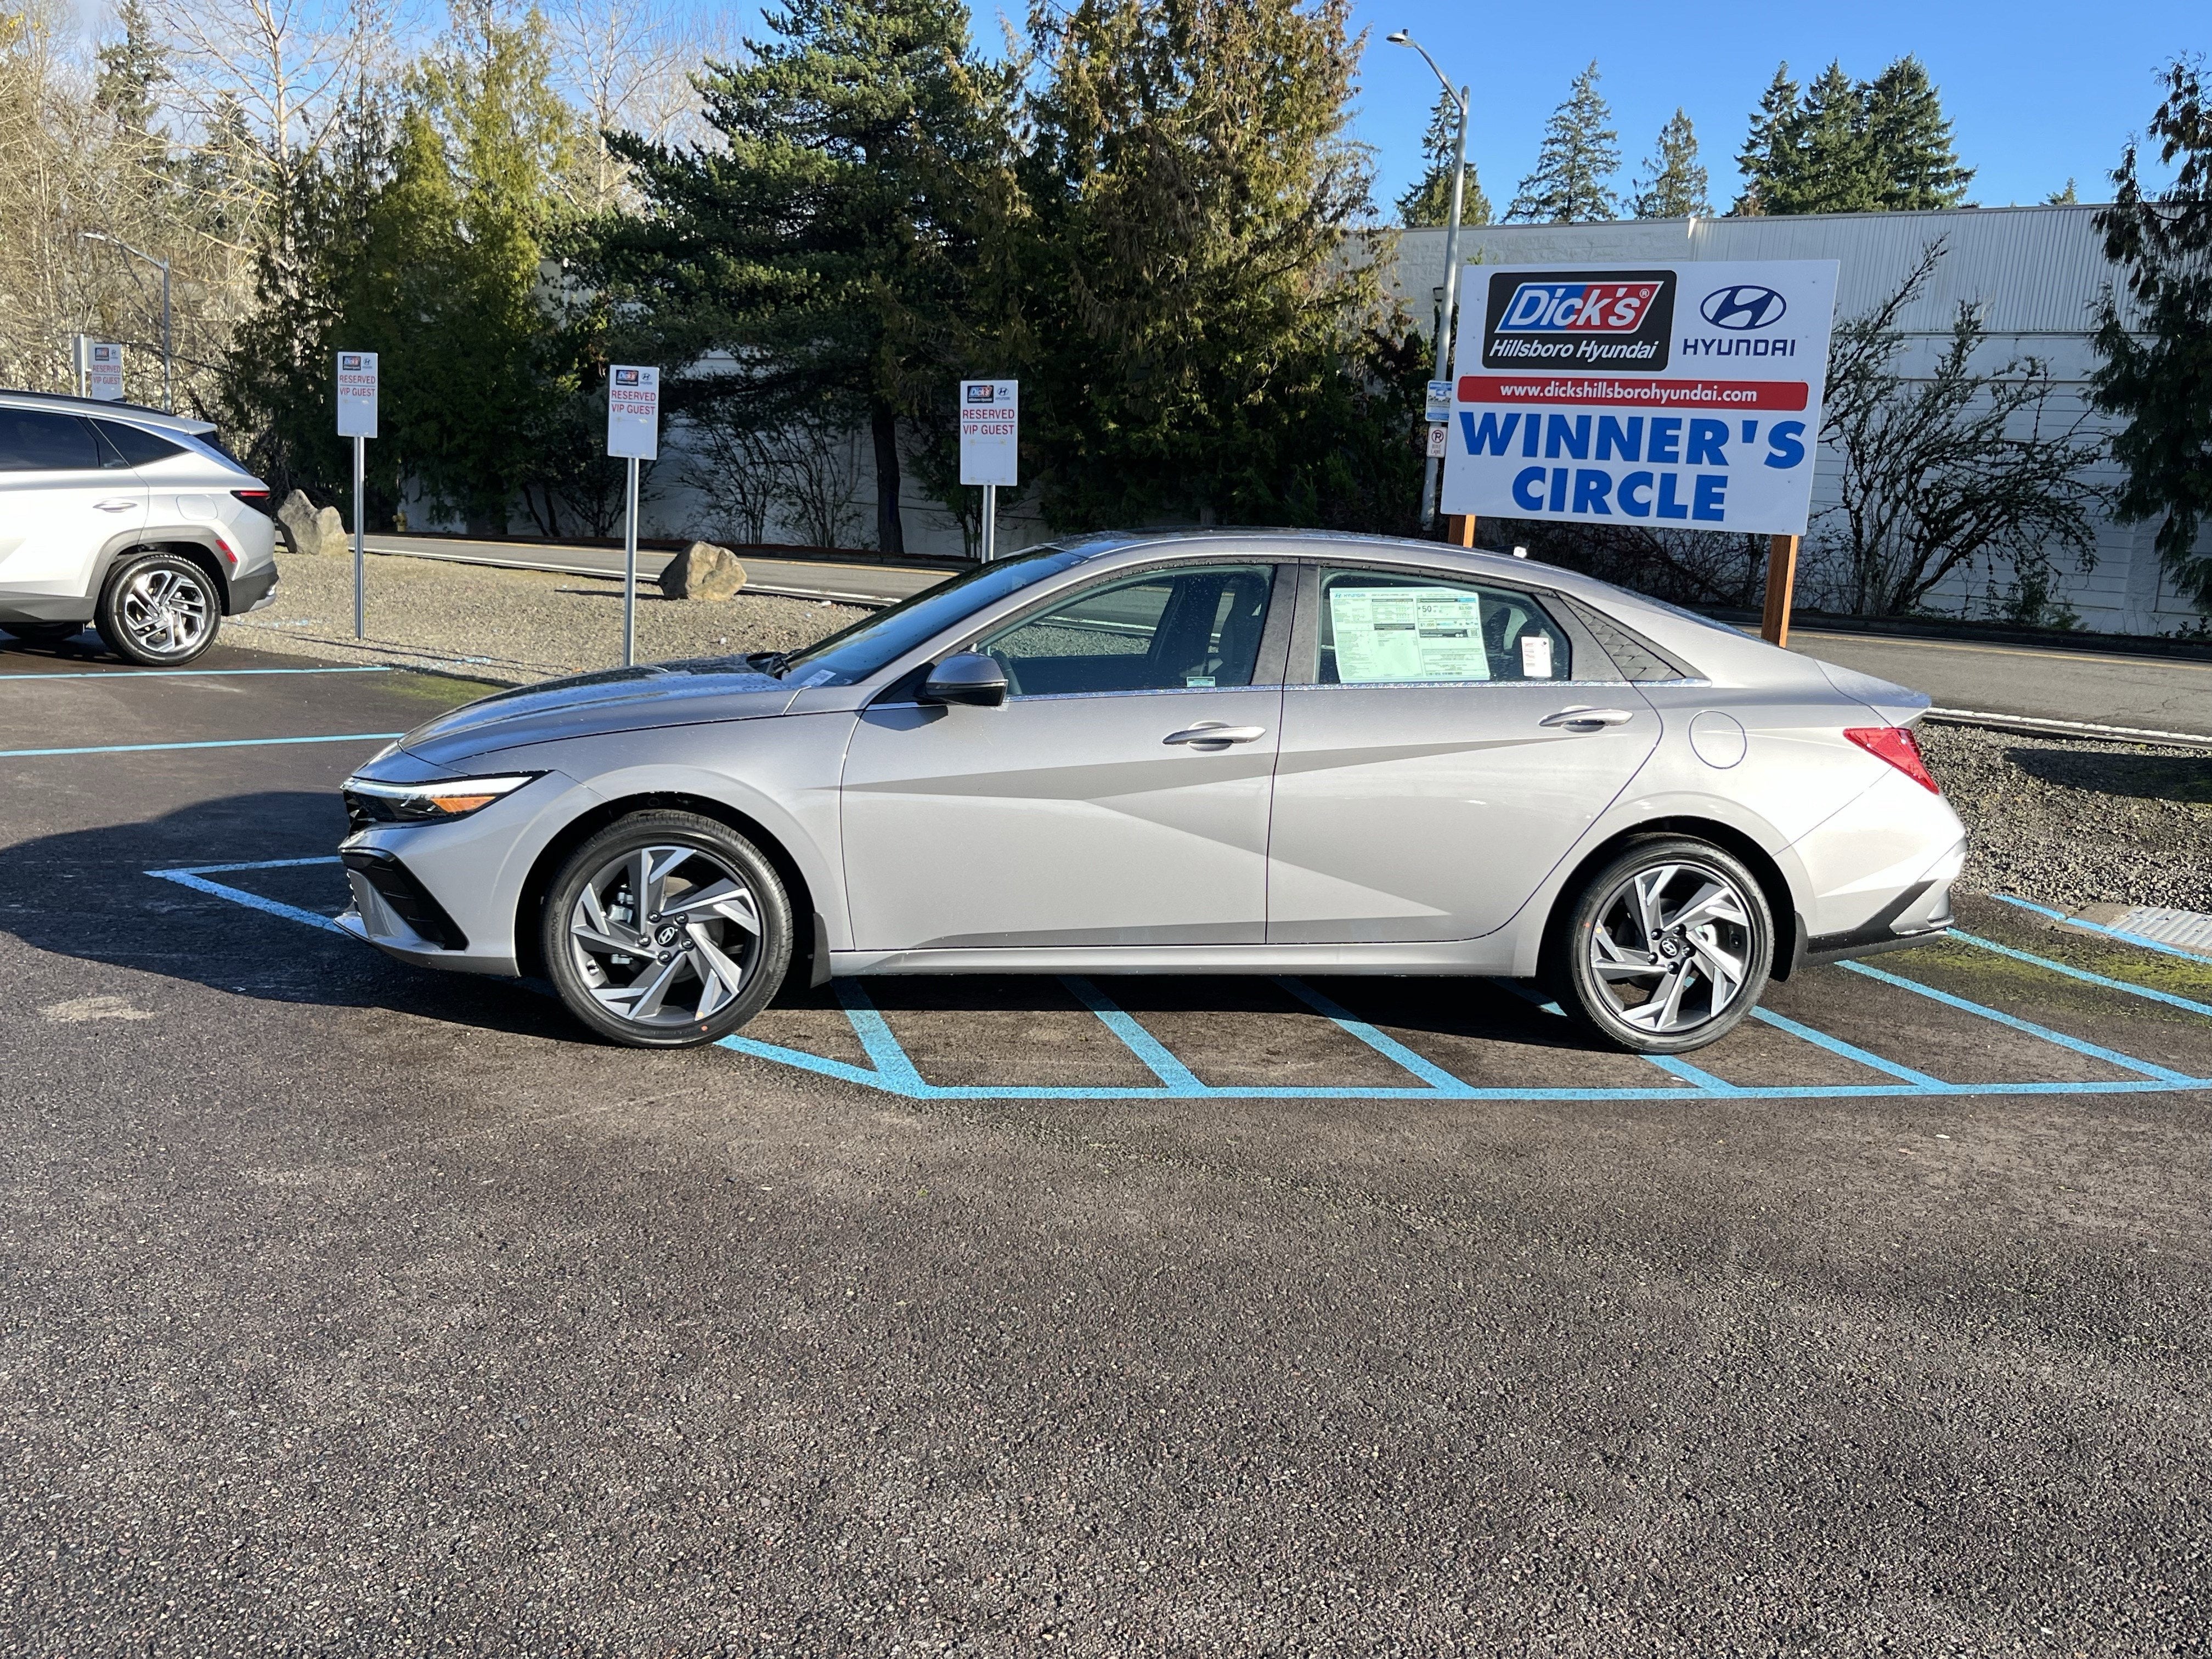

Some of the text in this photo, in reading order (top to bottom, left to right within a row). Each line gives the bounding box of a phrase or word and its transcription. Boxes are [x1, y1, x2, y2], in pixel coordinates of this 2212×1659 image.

[1489, 339, 1659, 362] Hillsboro Hyundai
[1683, 338, 1796, 357] HYUNDAI
[93, 364, 121, 373] RESERVED
[103, 376, 121, 385] GUEST
[339, 375, 376, 384] RESERVED
[340, 387, 376, 397] VIP GUEST
[611, 390, 656, 402] RESERVED
[1500, 382, 1757, 404] www.dickshillsborohyundai.com
[611, 404, 656, 415] VIP GUEST
[962, 409, 1015, 419] RESERVED
[963, 425, 1014, 435] VIP GUEST
[1458, 411, 1807, 470] WINNER'S
[1512, 466, 1728, 522] CIRCLE
